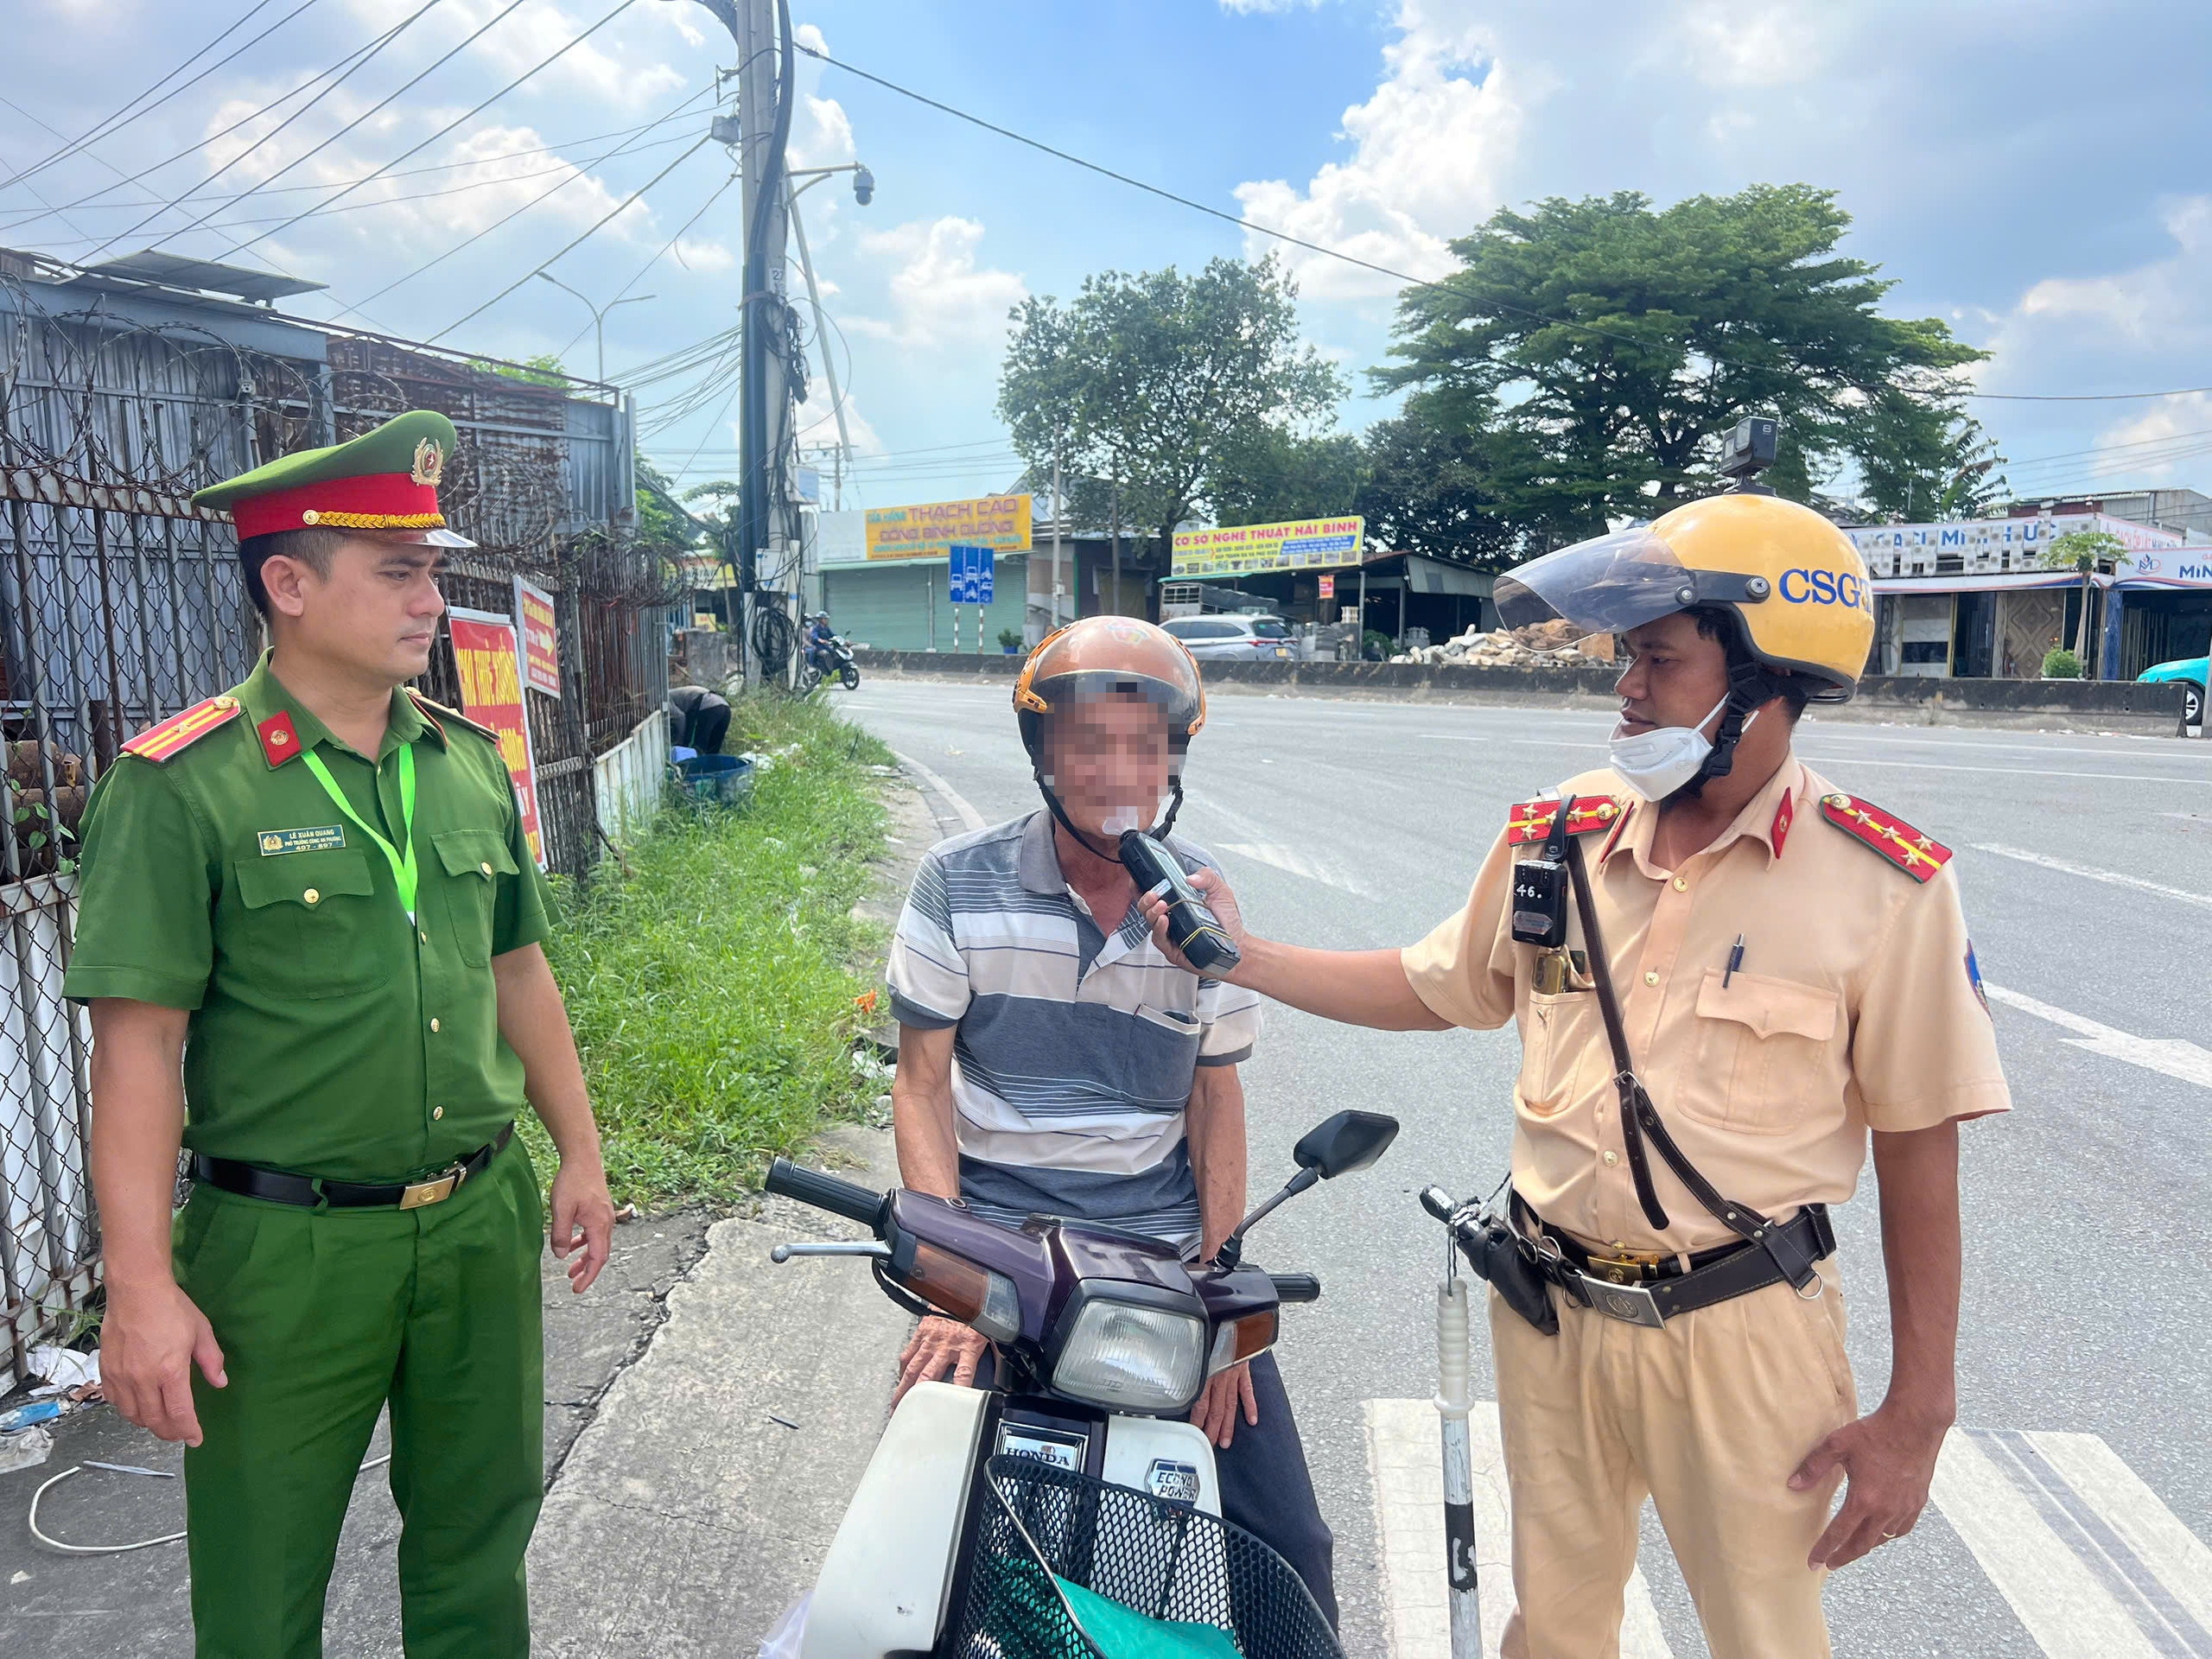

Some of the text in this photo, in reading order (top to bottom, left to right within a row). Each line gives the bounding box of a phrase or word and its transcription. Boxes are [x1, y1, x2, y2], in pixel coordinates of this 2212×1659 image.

[977, 498, 1019, 516] CAO
[1005, 1446, 1069, 1466] HONDA
[1158, 1484, 1197, 1500] POWER
